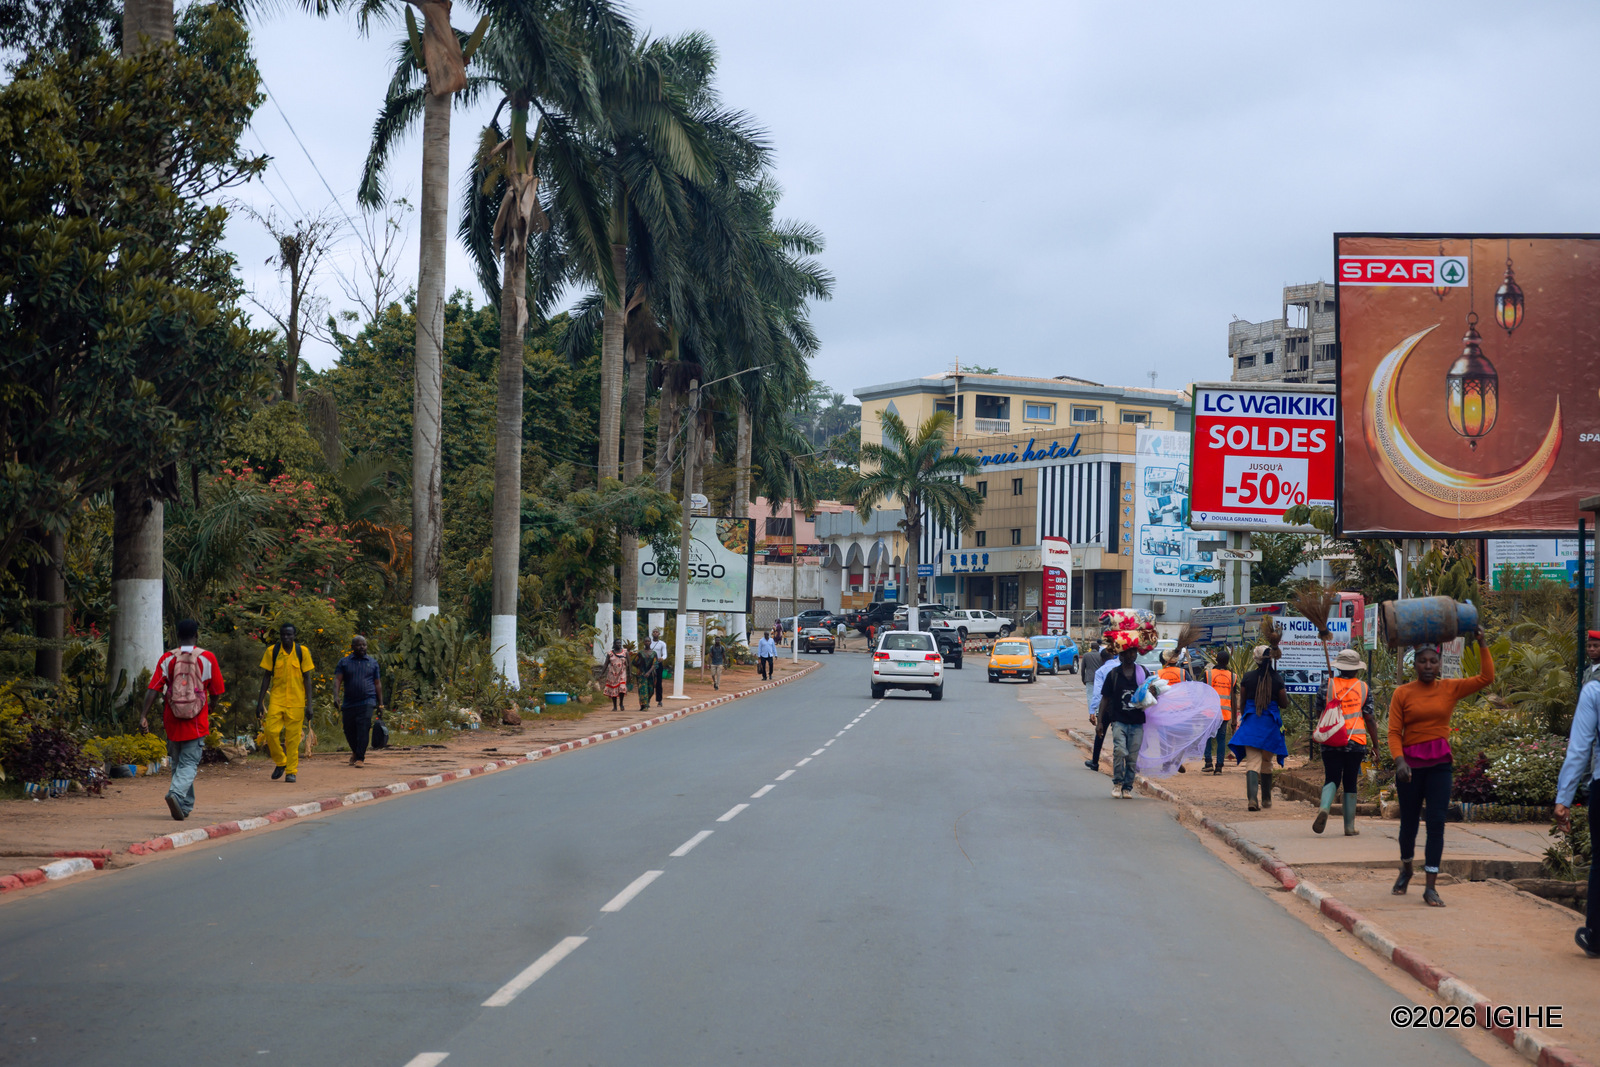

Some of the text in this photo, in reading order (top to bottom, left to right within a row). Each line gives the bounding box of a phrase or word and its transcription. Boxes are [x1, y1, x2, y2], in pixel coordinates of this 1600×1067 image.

[1342, 262, 1433, 279] SPAR
[1204, 394, 1235, 413] LC
[1022, 433, 1081, 462] hotel
[1208, 424, 1327, 453] SOLDES
[1225, 472, 1306, 506] -50%
[1327, 621, 1347, 631] CLIM
